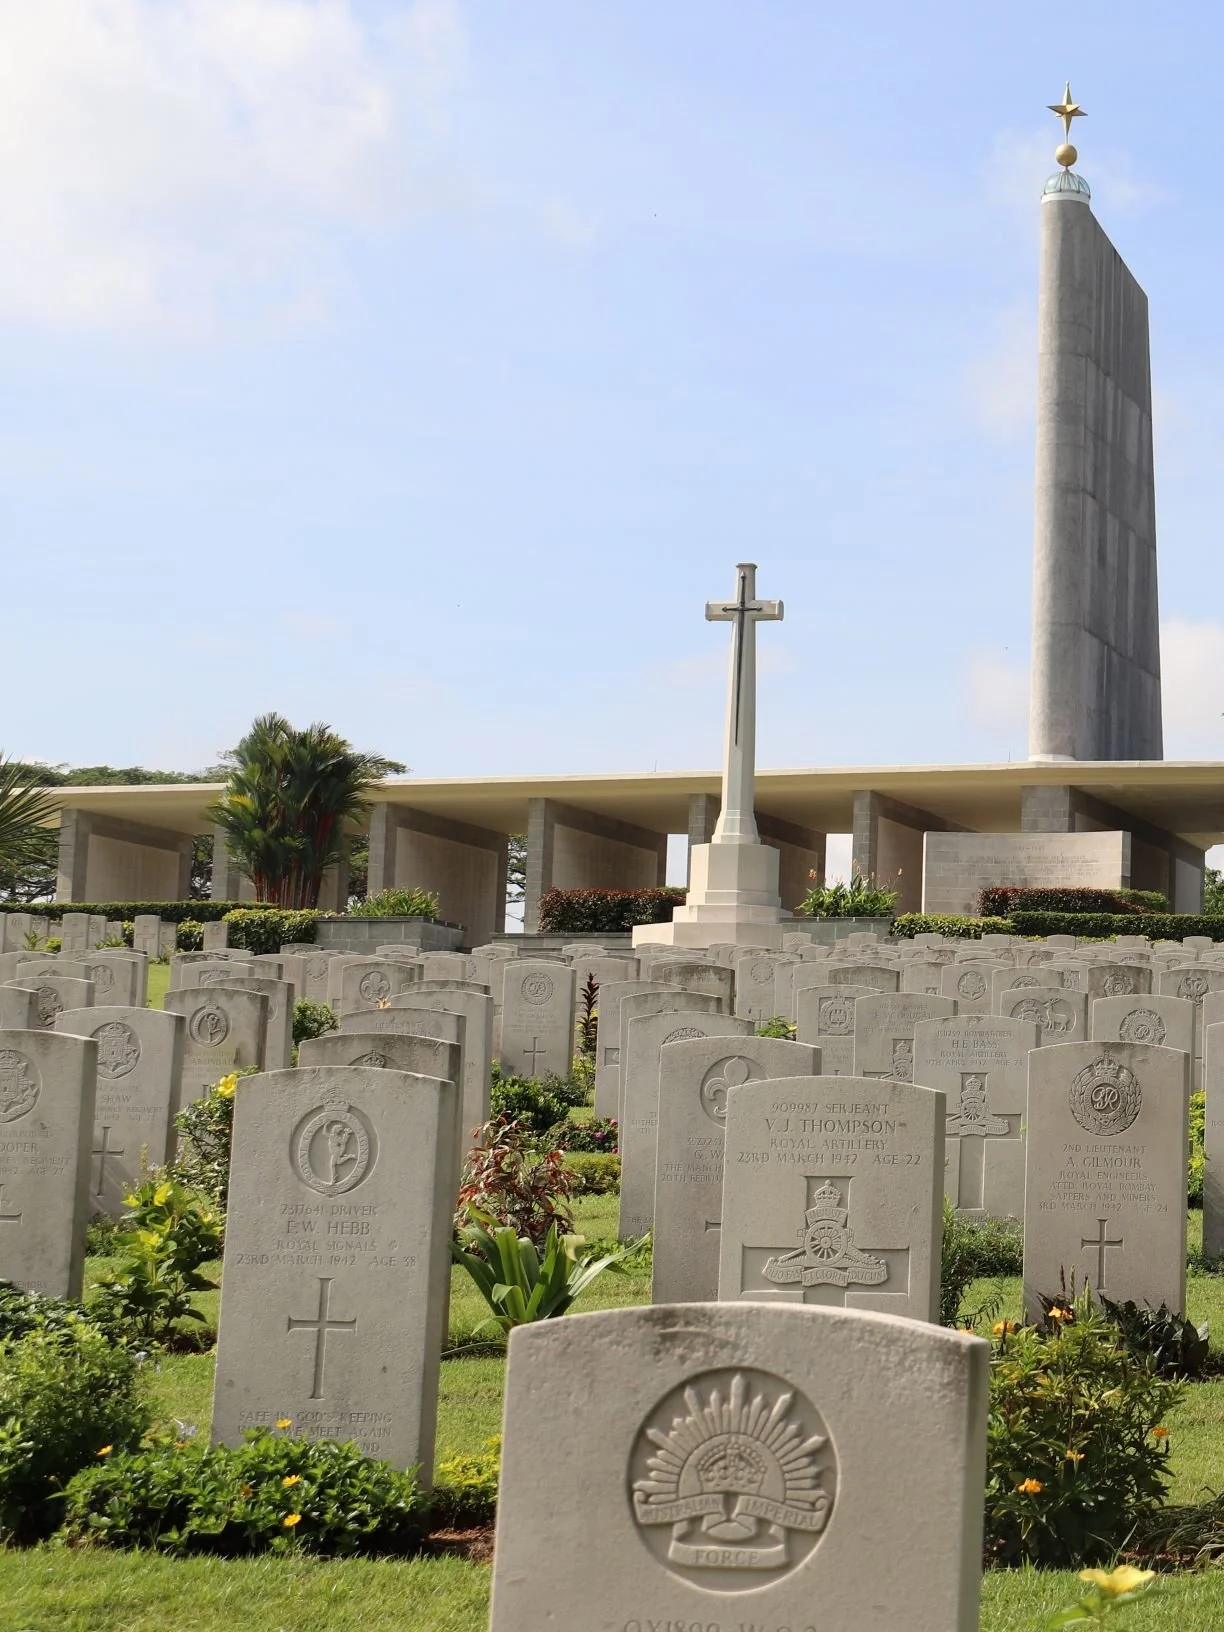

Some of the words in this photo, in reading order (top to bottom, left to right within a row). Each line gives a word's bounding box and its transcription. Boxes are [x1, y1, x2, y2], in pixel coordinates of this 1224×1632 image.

[974, 1040, 999, 1049] BASS
[102, 1094, 132, 1102] SHAW
[770, 1102, 818, 1113] 909987
[825, 1103, 889, 1114] SERJEANT
[801, 1119, 896, 1134] THOMPSON
[769, 1138, 815, 1150] ROYAL
[822, 1138, 887, 1150] ARTILLERY
[1064, 1144, 1082, 1153] 2ND
[1087, 1144, 1147, 1154] LIEUTENANT
[737, 1152, 769, 1163] 23RD
[776, 1153, 824, 1165] MARCH
[831, 1153, 857, 1165] 1942
[872, 1154, 899, 1166] AGE
[905, 1155, 921, 1167] 22
[1066, 1156, 1079, 1168] A.
[1083, 1157, 1142, 1169] GILMOUR
[664, 1163, 683, 1172] THE
[687, 1163, 723, 1172] MANCH
[1060, 1171, 1091, 1180] ROYAL
[1097, 1172, 1148, 1181] ENGINEERS
[1082, 1182, 1113, 1191] ROYAL
[1119, 1183, 1157, 1192] BOMBAY
[1051, 1192, 1090, 1201] SAPPERS
[1096, 1193, 1117, 1202] AND
[1122, 1193, 1156, 1202] MINERS
[331, 1204, 377, 1216] DRIVER
[1062, 1202, 1097, 1211] MARCH
[1102, 1203, 1122, 1212] 1942
[327, 1221, 370, 1236] HEBB
[276, 1240, 319, 1252] ROYAL
[326, 1240, 376, 1252] SIGNALS
[236, 1253, 270, 1266] 23RD
[275, 1254, 323, 1266] MARCH
[329, 1254, 357, 1267] 1942
[369, 1255, 397, 1268] AGE
[238, 1411, 271, 1422] SAFE
[339, 1412, 393, 1424] KEEPING
[309, 1426, 344, 1438] MEET
[350, 1427, 393, 1438] AGAIN
[641, 1498, 723, 1522] AUSTRALIAN
[743, 1500, 819, 1527] IMPERIAL
[694, 1549, 760, 1565] FORCE
